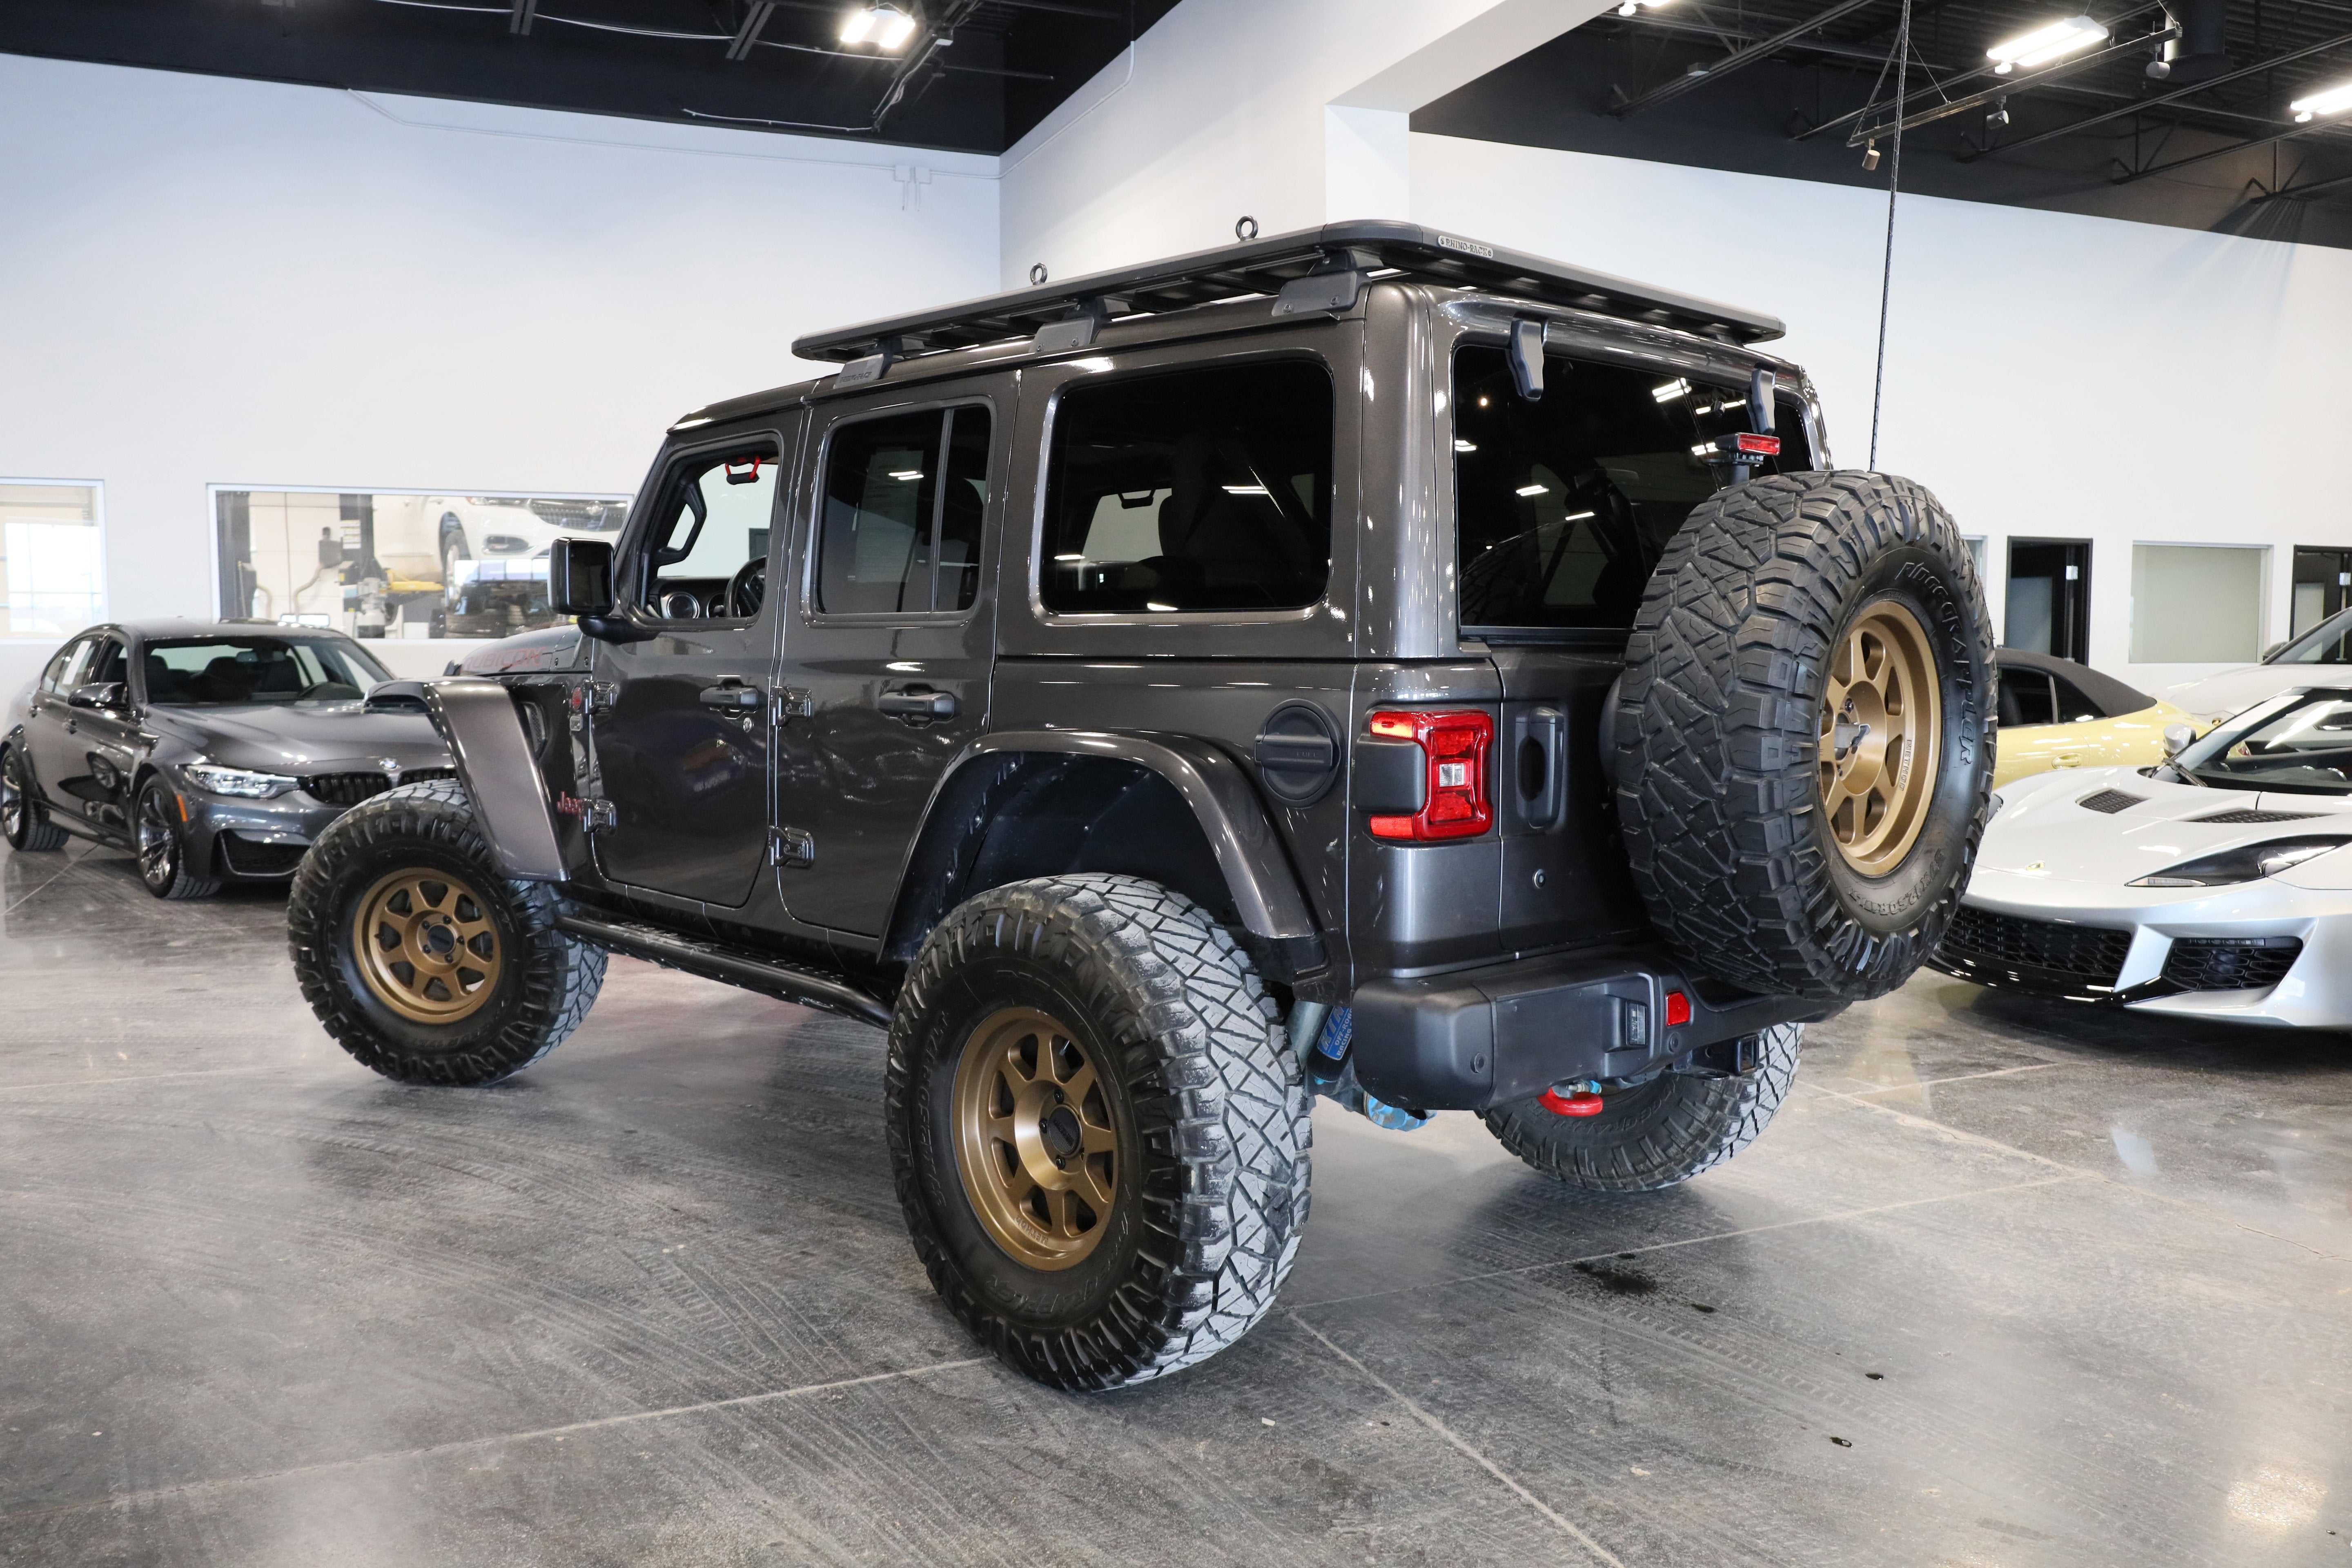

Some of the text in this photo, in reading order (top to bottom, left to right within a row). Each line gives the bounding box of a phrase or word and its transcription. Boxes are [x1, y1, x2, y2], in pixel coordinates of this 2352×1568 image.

[1446, 238, 1487, 256] RHINO-RACK
[462, 647, 546, 670] RUBICON
[1895, 561, 1977, 764] RIDGE GRAPPLER
[1900, 739, 1912, 791] METHOD
[557, 791, 582, 821] Jeep
[1321, 1007, 1344, 1051] KIN
[1336, 1028, 1352, 1056] RACING
